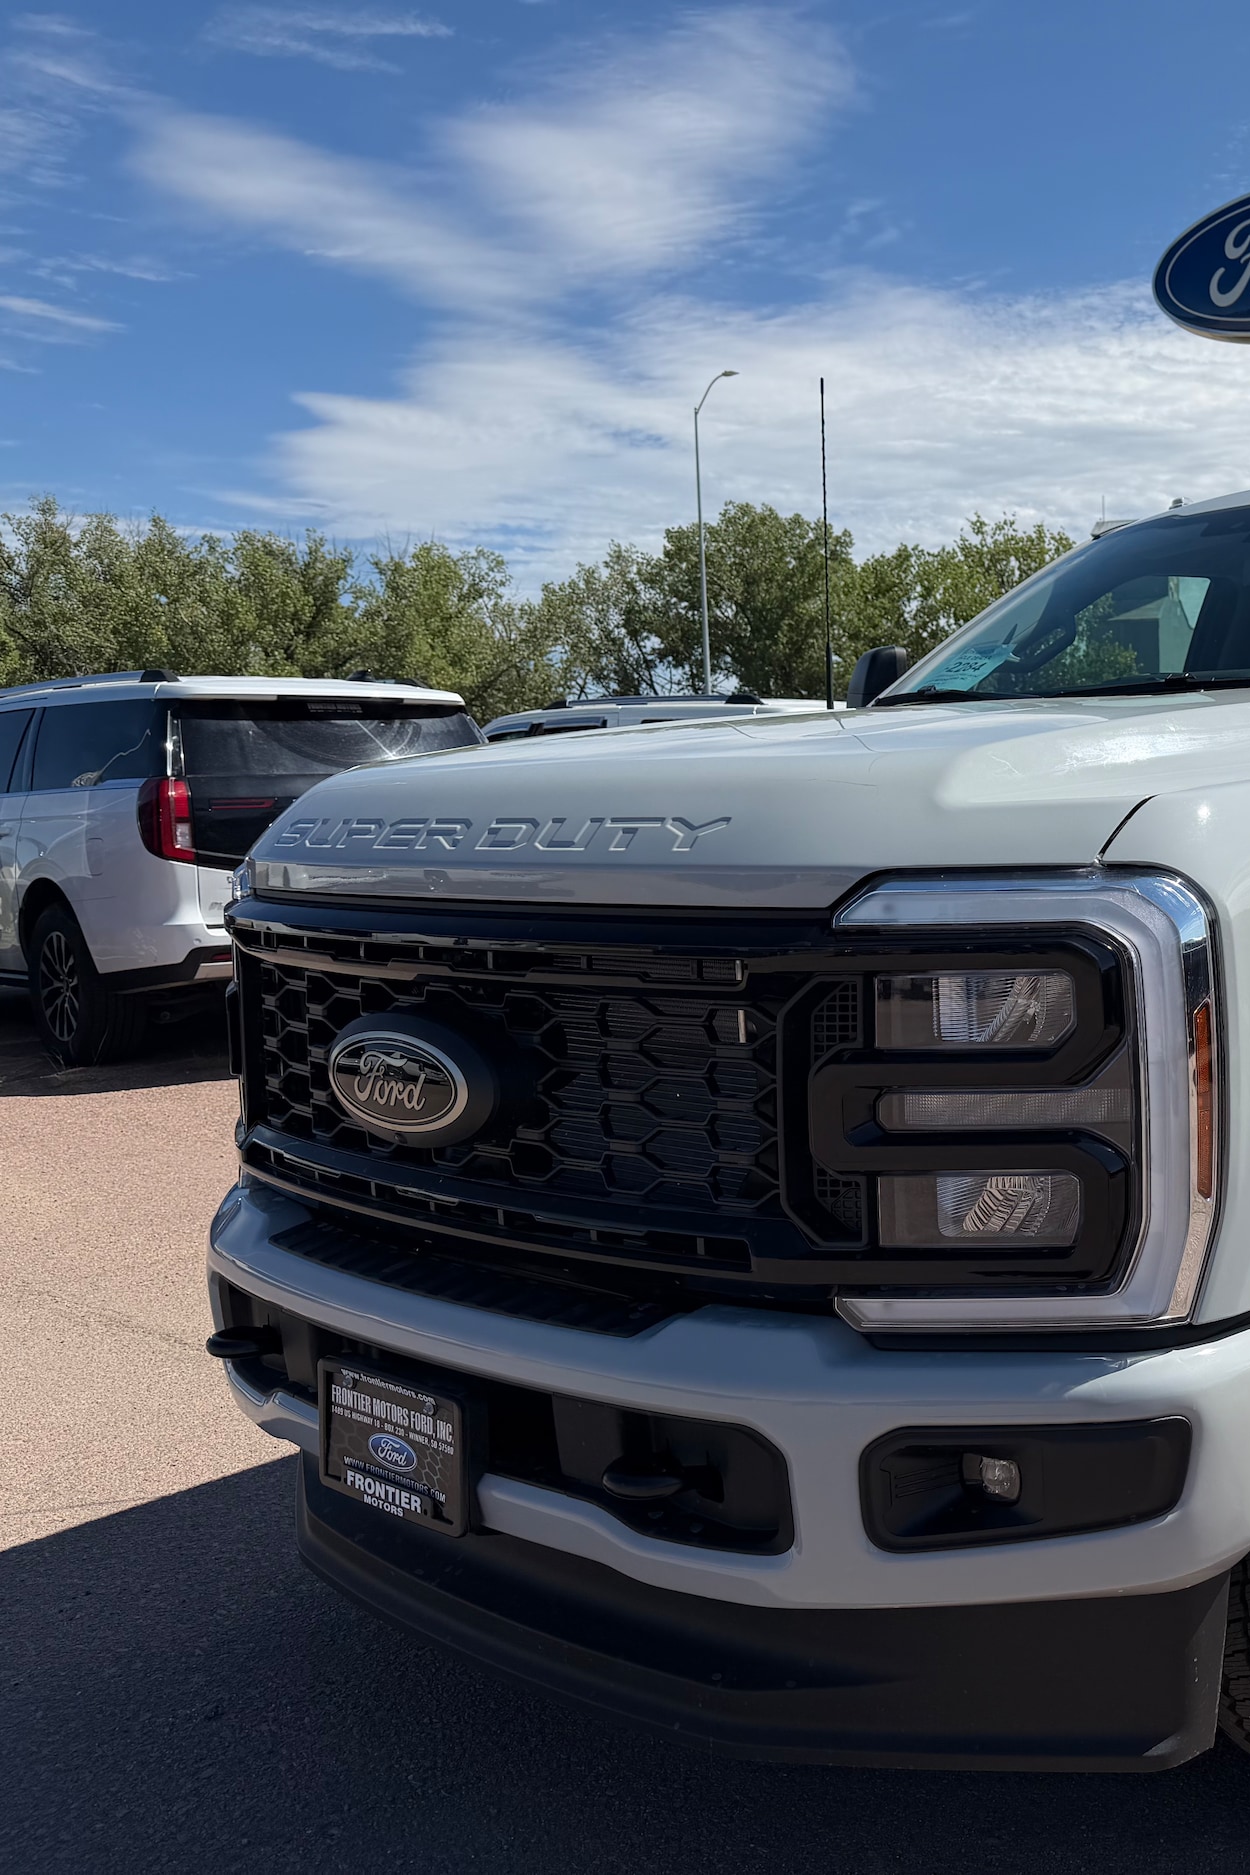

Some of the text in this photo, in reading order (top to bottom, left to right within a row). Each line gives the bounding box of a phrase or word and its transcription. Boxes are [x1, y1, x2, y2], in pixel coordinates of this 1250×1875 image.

[274, 817, 732, 851] SUPER DUTY
[354, 1051, 427, 1111] Ford
[340, 1368, 436, 1406] www.frontiermotors.com
[331, 1384, 454, 1444] FRONTIER MOTORS FORD, INC.
[352, 1411, 373, 1425] HIGHWAY
[384, 1422, 395, 1434] BOX
[409, 1431, 430, 1447] WINNER,
[431, 1439, 438, 1449] SD
[378, 1438, 407, 1466] Ford
[343, 1455, 447, 1504] WWW.FRONTIERMOTORS.COM
[346, 1470, 422, 1514] FRONTIER
[363, 1494, 404, 1517] MOTORS
